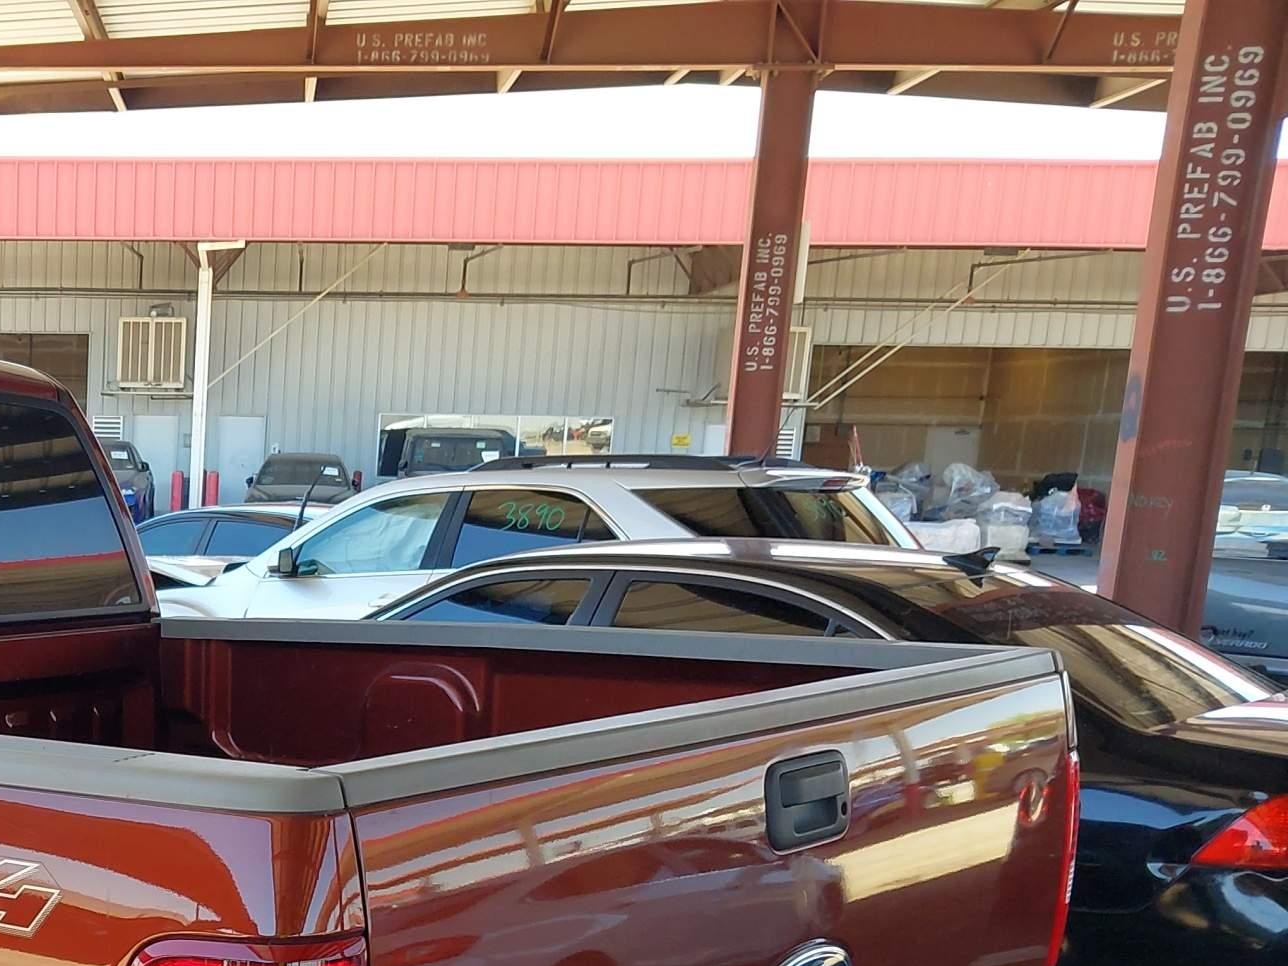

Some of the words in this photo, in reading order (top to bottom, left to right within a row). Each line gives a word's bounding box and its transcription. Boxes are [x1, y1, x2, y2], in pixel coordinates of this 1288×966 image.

[356, 33, 386, 48] US.
[394, 33, 455, 47] PREFAB
[1176, 121, 1218, 239] PREFAB
[1197, 46, 1265, 310] 1-866-799-0969
[756, 232, 773, 263] INC.
[748, 271, 768, 333] PREFAB
[760, 234, 788, 370] 1-866-799-0969
[1165, 257, 1198, 313] U.S.
[745, 341, 761, 372] U.S.
[496, 501, 565, 531] 3890
